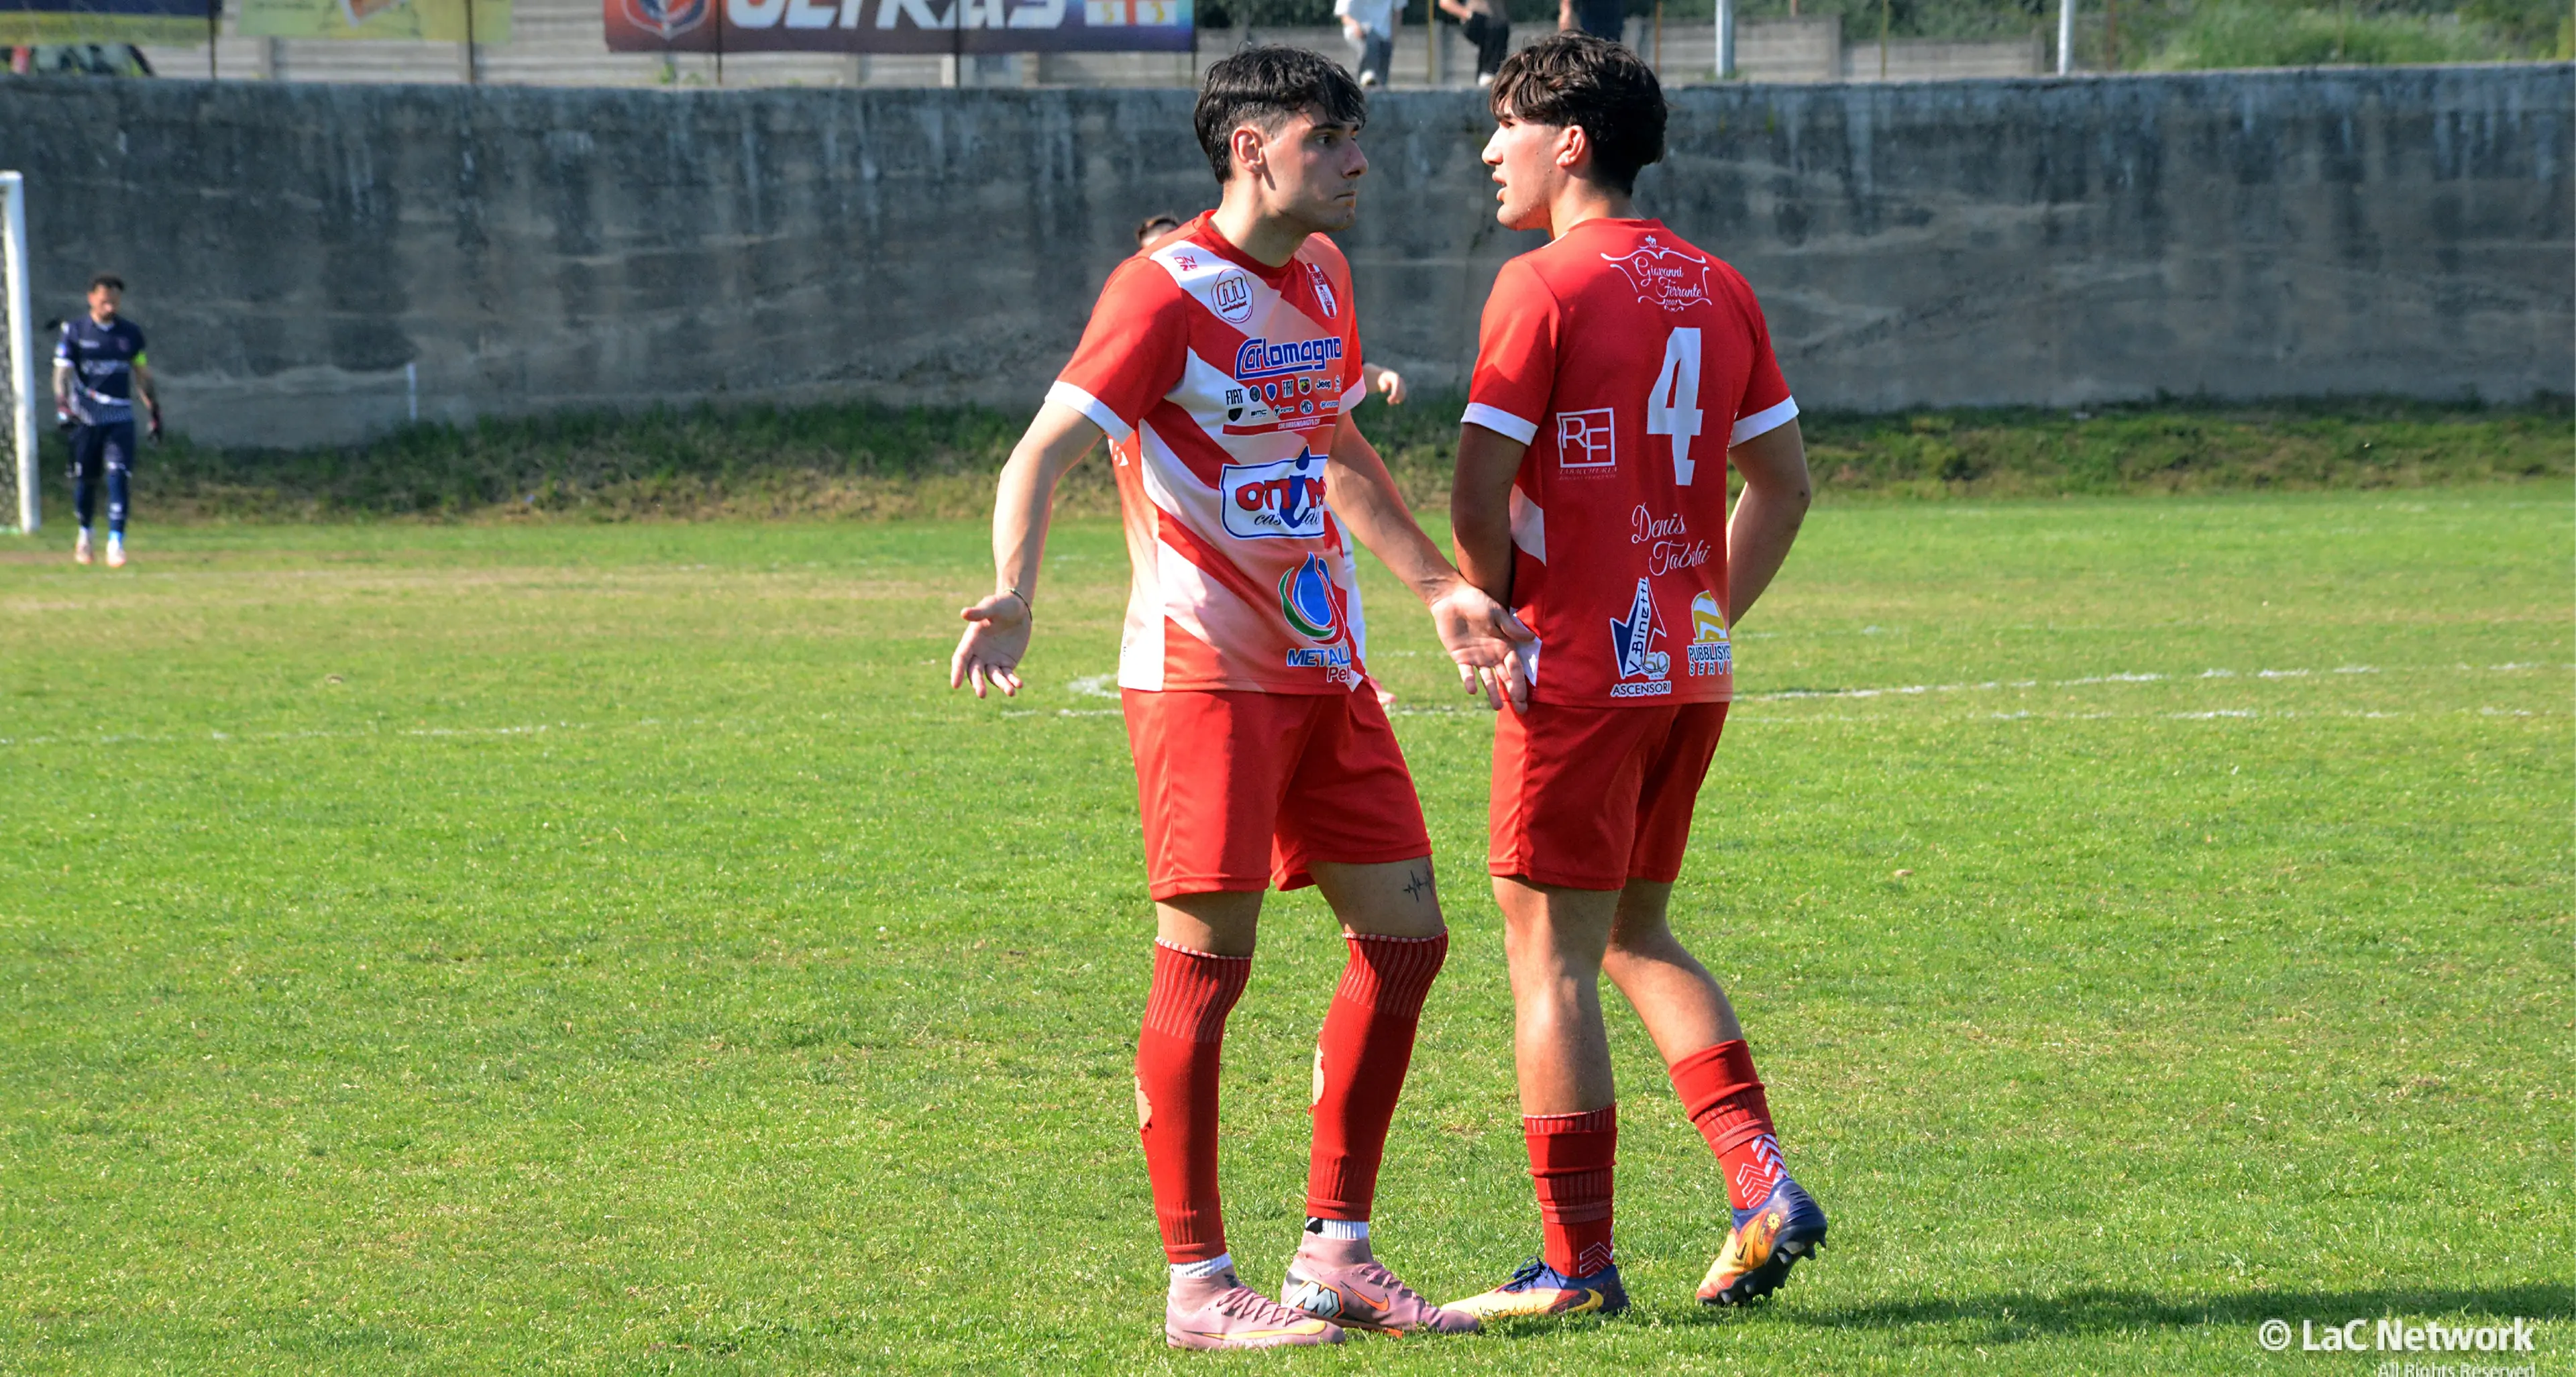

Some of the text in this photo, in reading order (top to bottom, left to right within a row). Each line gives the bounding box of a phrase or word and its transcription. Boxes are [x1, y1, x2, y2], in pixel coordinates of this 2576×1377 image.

[1631, 256, 1683, 286] Giovanni
[1656, 276, 1702, 298] Ferrante
[1283, 380, 1293, 397] FIAT
[1316, 379, 1332, 390] Jeep
[1226, 389, 1243, 405] FIAT
[1647, 327, 1703, 486] 4
[1562, 417, 1609, 461] RF
[1631, 502, 1686, 544] Denis
[1612, 683, 1670, 696] ASCENSORI
